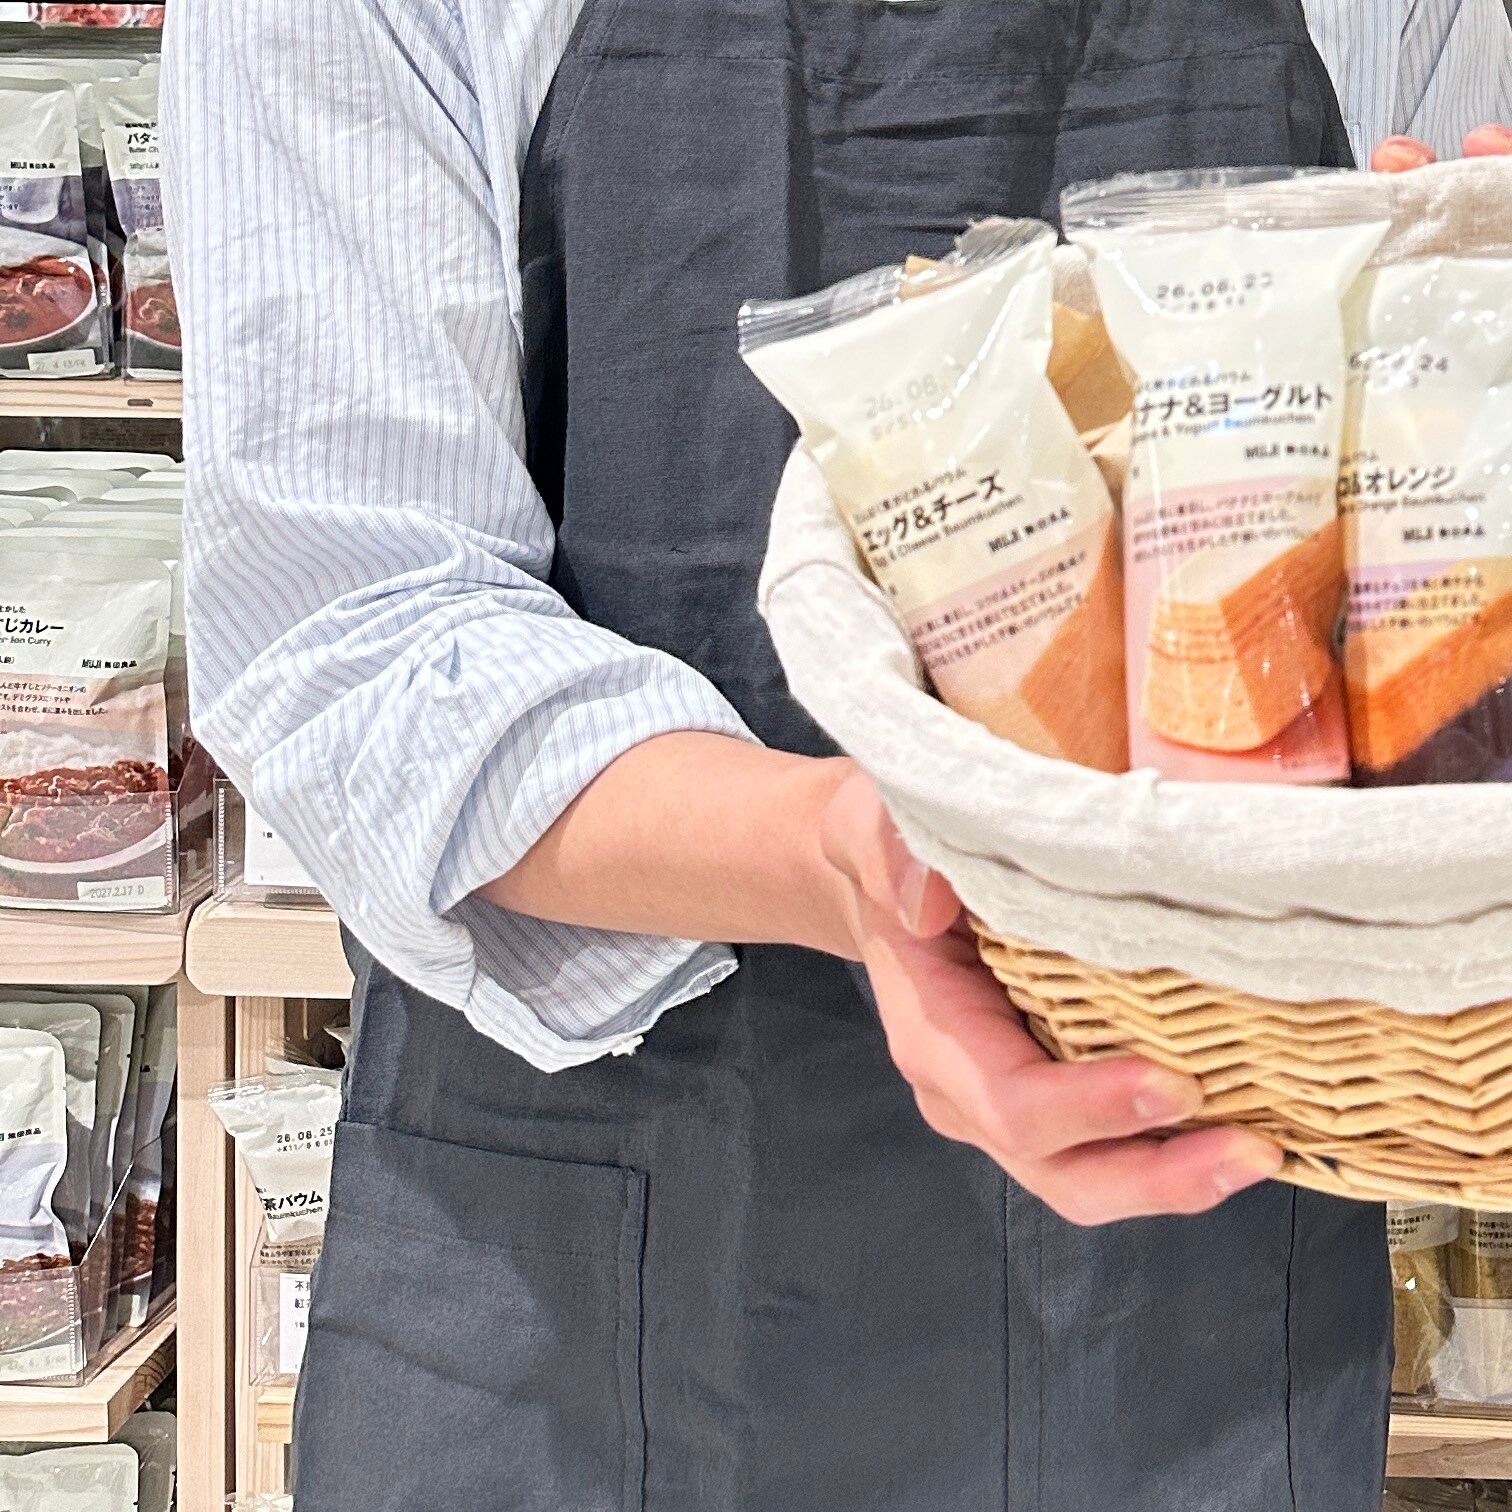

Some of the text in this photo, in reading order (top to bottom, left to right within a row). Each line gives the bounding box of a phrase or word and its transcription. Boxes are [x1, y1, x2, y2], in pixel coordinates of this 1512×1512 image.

[1245, 444, 1280, 460] MUJI
[862, 469, 1004, 552] エッグ&チーズ
[988, 529, 1019, 554] MUJI
[1403, 527, 1432, 542] MUJI
[27, 637, 51, 646] Curry
[82, 659, 137, 669] MUJI 無印良品
[277, 1126, 333, 1143] 26.08.25
[263, 1191, 323, 1211] 茶バウム
